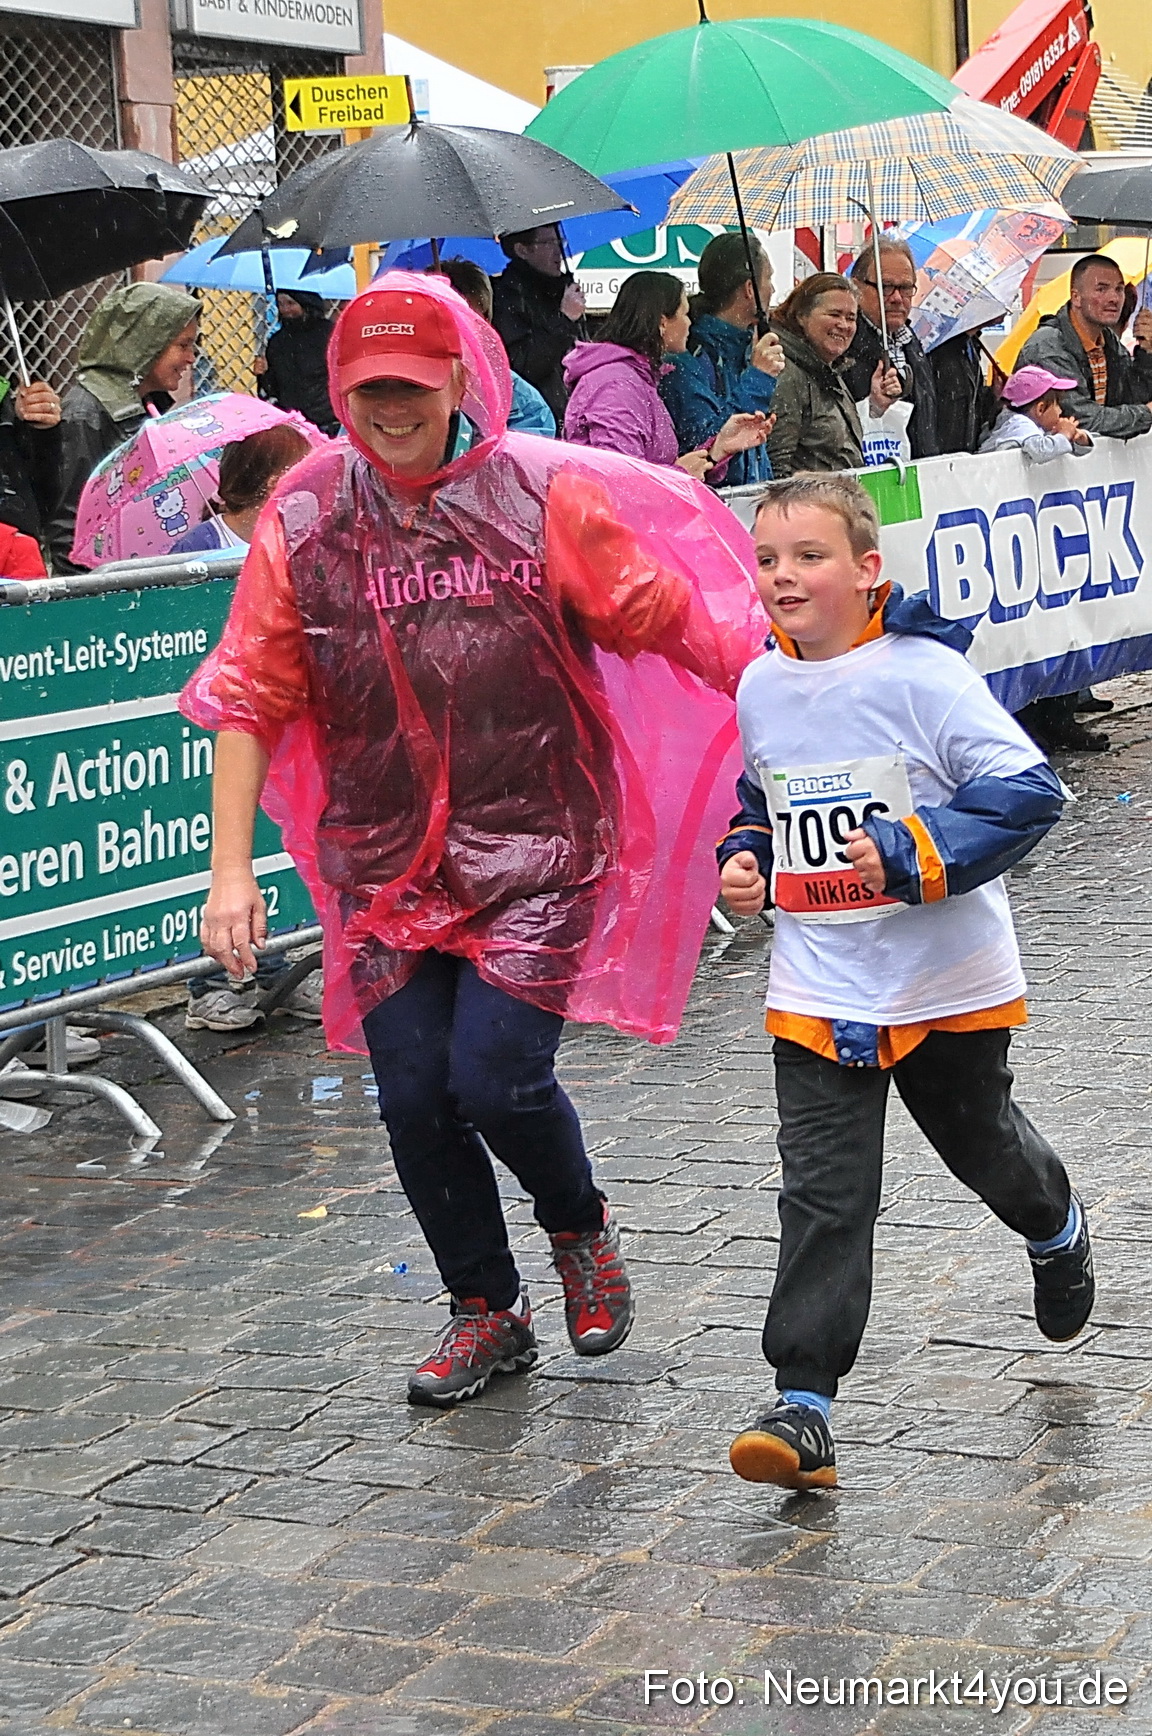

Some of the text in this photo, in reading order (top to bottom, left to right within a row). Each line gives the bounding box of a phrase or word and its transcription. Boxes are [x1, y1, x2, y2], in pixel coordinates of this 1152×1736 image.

[254, 0, 354, 26] KINDERMODEN
[311, 82, 389, 104] Duschen
[318, 103, 385, 124] Freibad
[361, 323, 415, 338] BOCK
[926, 481, 1144, 631] BOCK
[0, 625, 207, 683] vent-Leit-Systeme
[5, 726, 213, 815] & Action in
[786, 771, 853, 796] BOCK
[97, 808, 215, 876] Bahne
[776, 801, 890, 868] 709
[804, 881, 875, 906] Niklas
[12, 936, 96, 986] Service
[103, 923, 156, 960] Line:
[161, 904, 208, 945] 091
